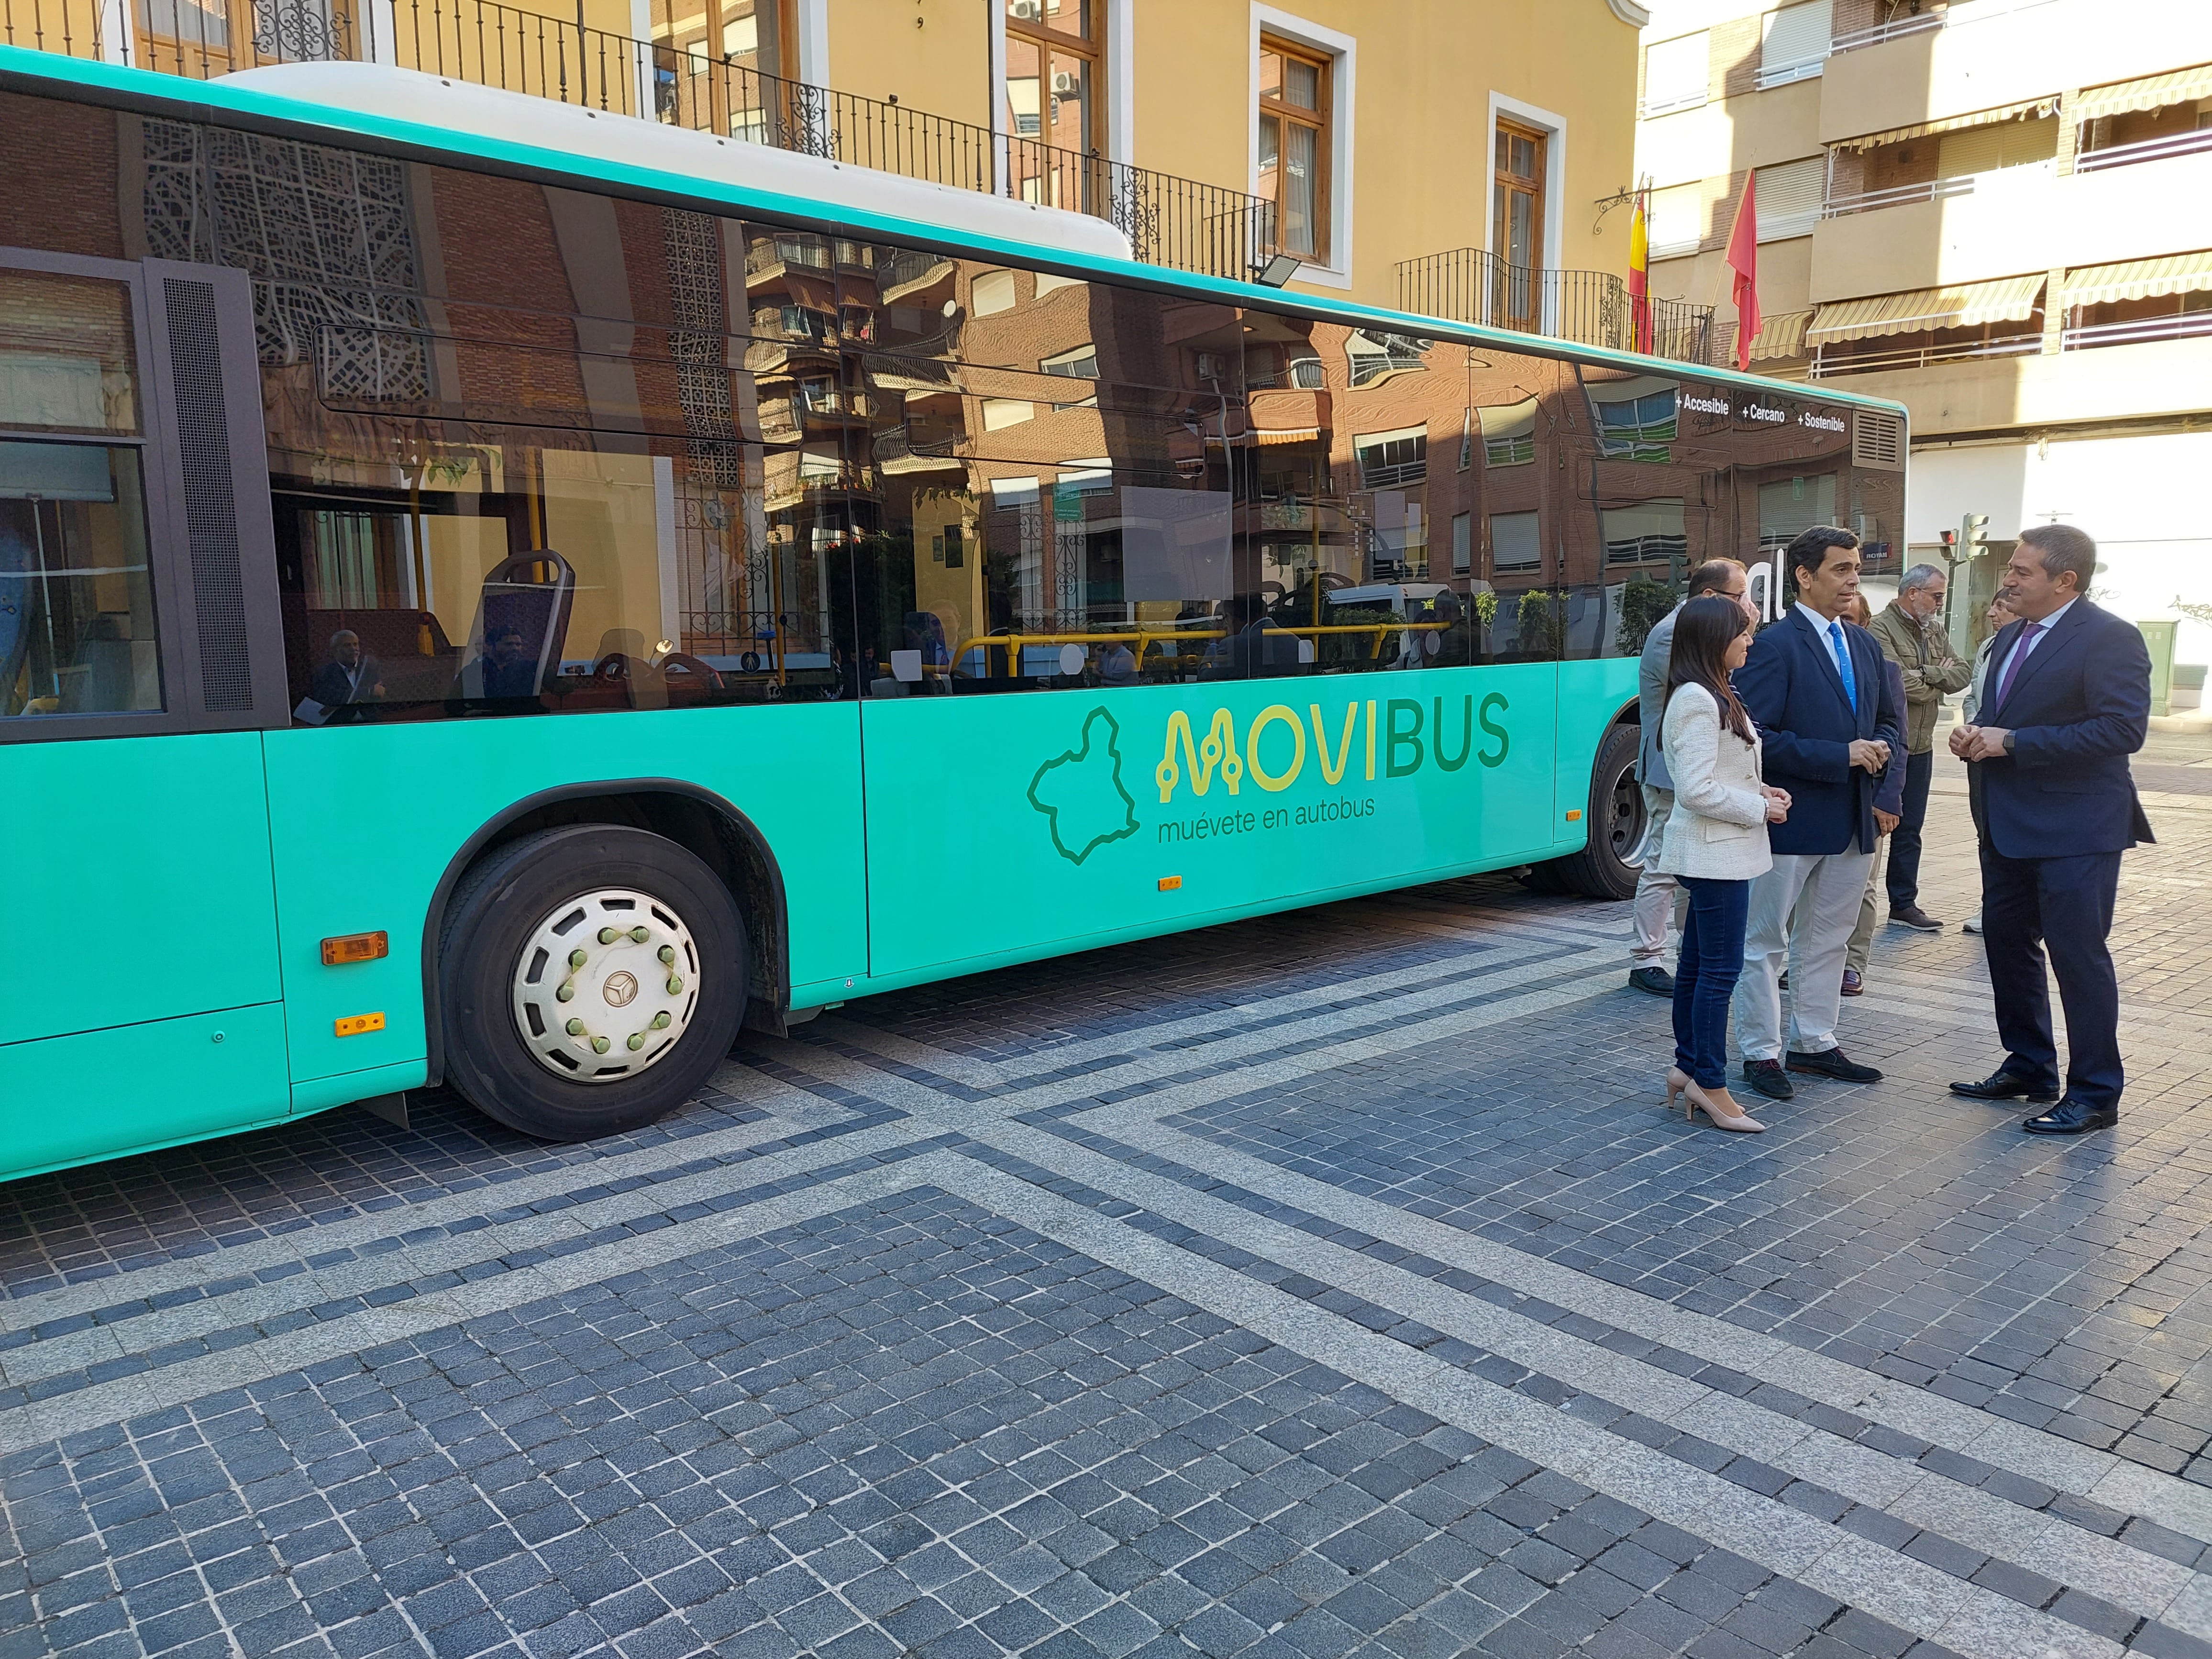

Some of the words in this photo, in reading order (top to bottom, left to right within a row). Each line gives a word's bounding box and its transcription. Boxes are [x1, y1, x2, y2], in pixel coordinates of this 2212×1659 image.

[1684, 393, 1729, 415] Accesible
[1750, 404, 1785, 422] Cercano
[1805, 412, 1845, 432] Sostenible
[1156, 692, 1510, 803] MOVIBUS
[1159, 809, 1256, 843] muévete
[1262, 807, 1288, 830] en
[1295, 795, 1375, 825] autobus
